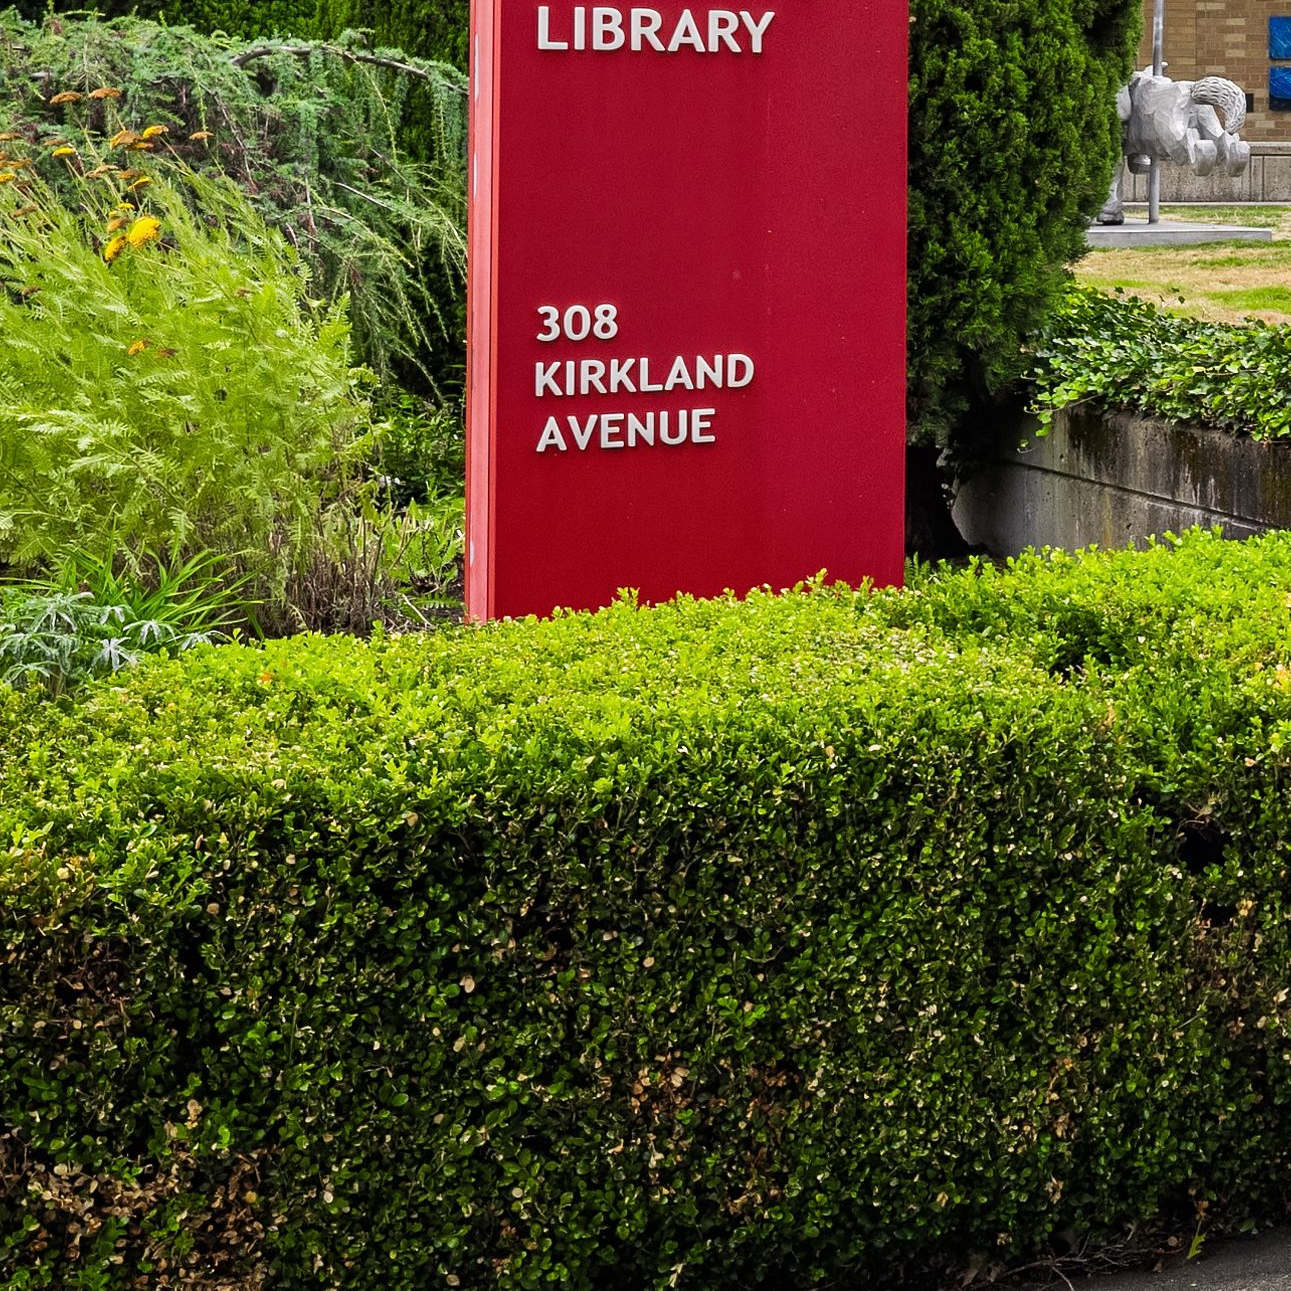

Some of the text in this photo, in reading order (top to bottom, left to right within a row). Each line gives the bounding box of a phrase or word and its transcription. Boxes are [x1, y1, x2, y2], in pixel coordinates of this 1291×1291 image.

[537, 6, 775, 53] LIBRARY
[536, 304, 618, 342] 308
[535, 354, 754, 396] KIRKLAND
[536, 408, 716, 452] AVENUE
